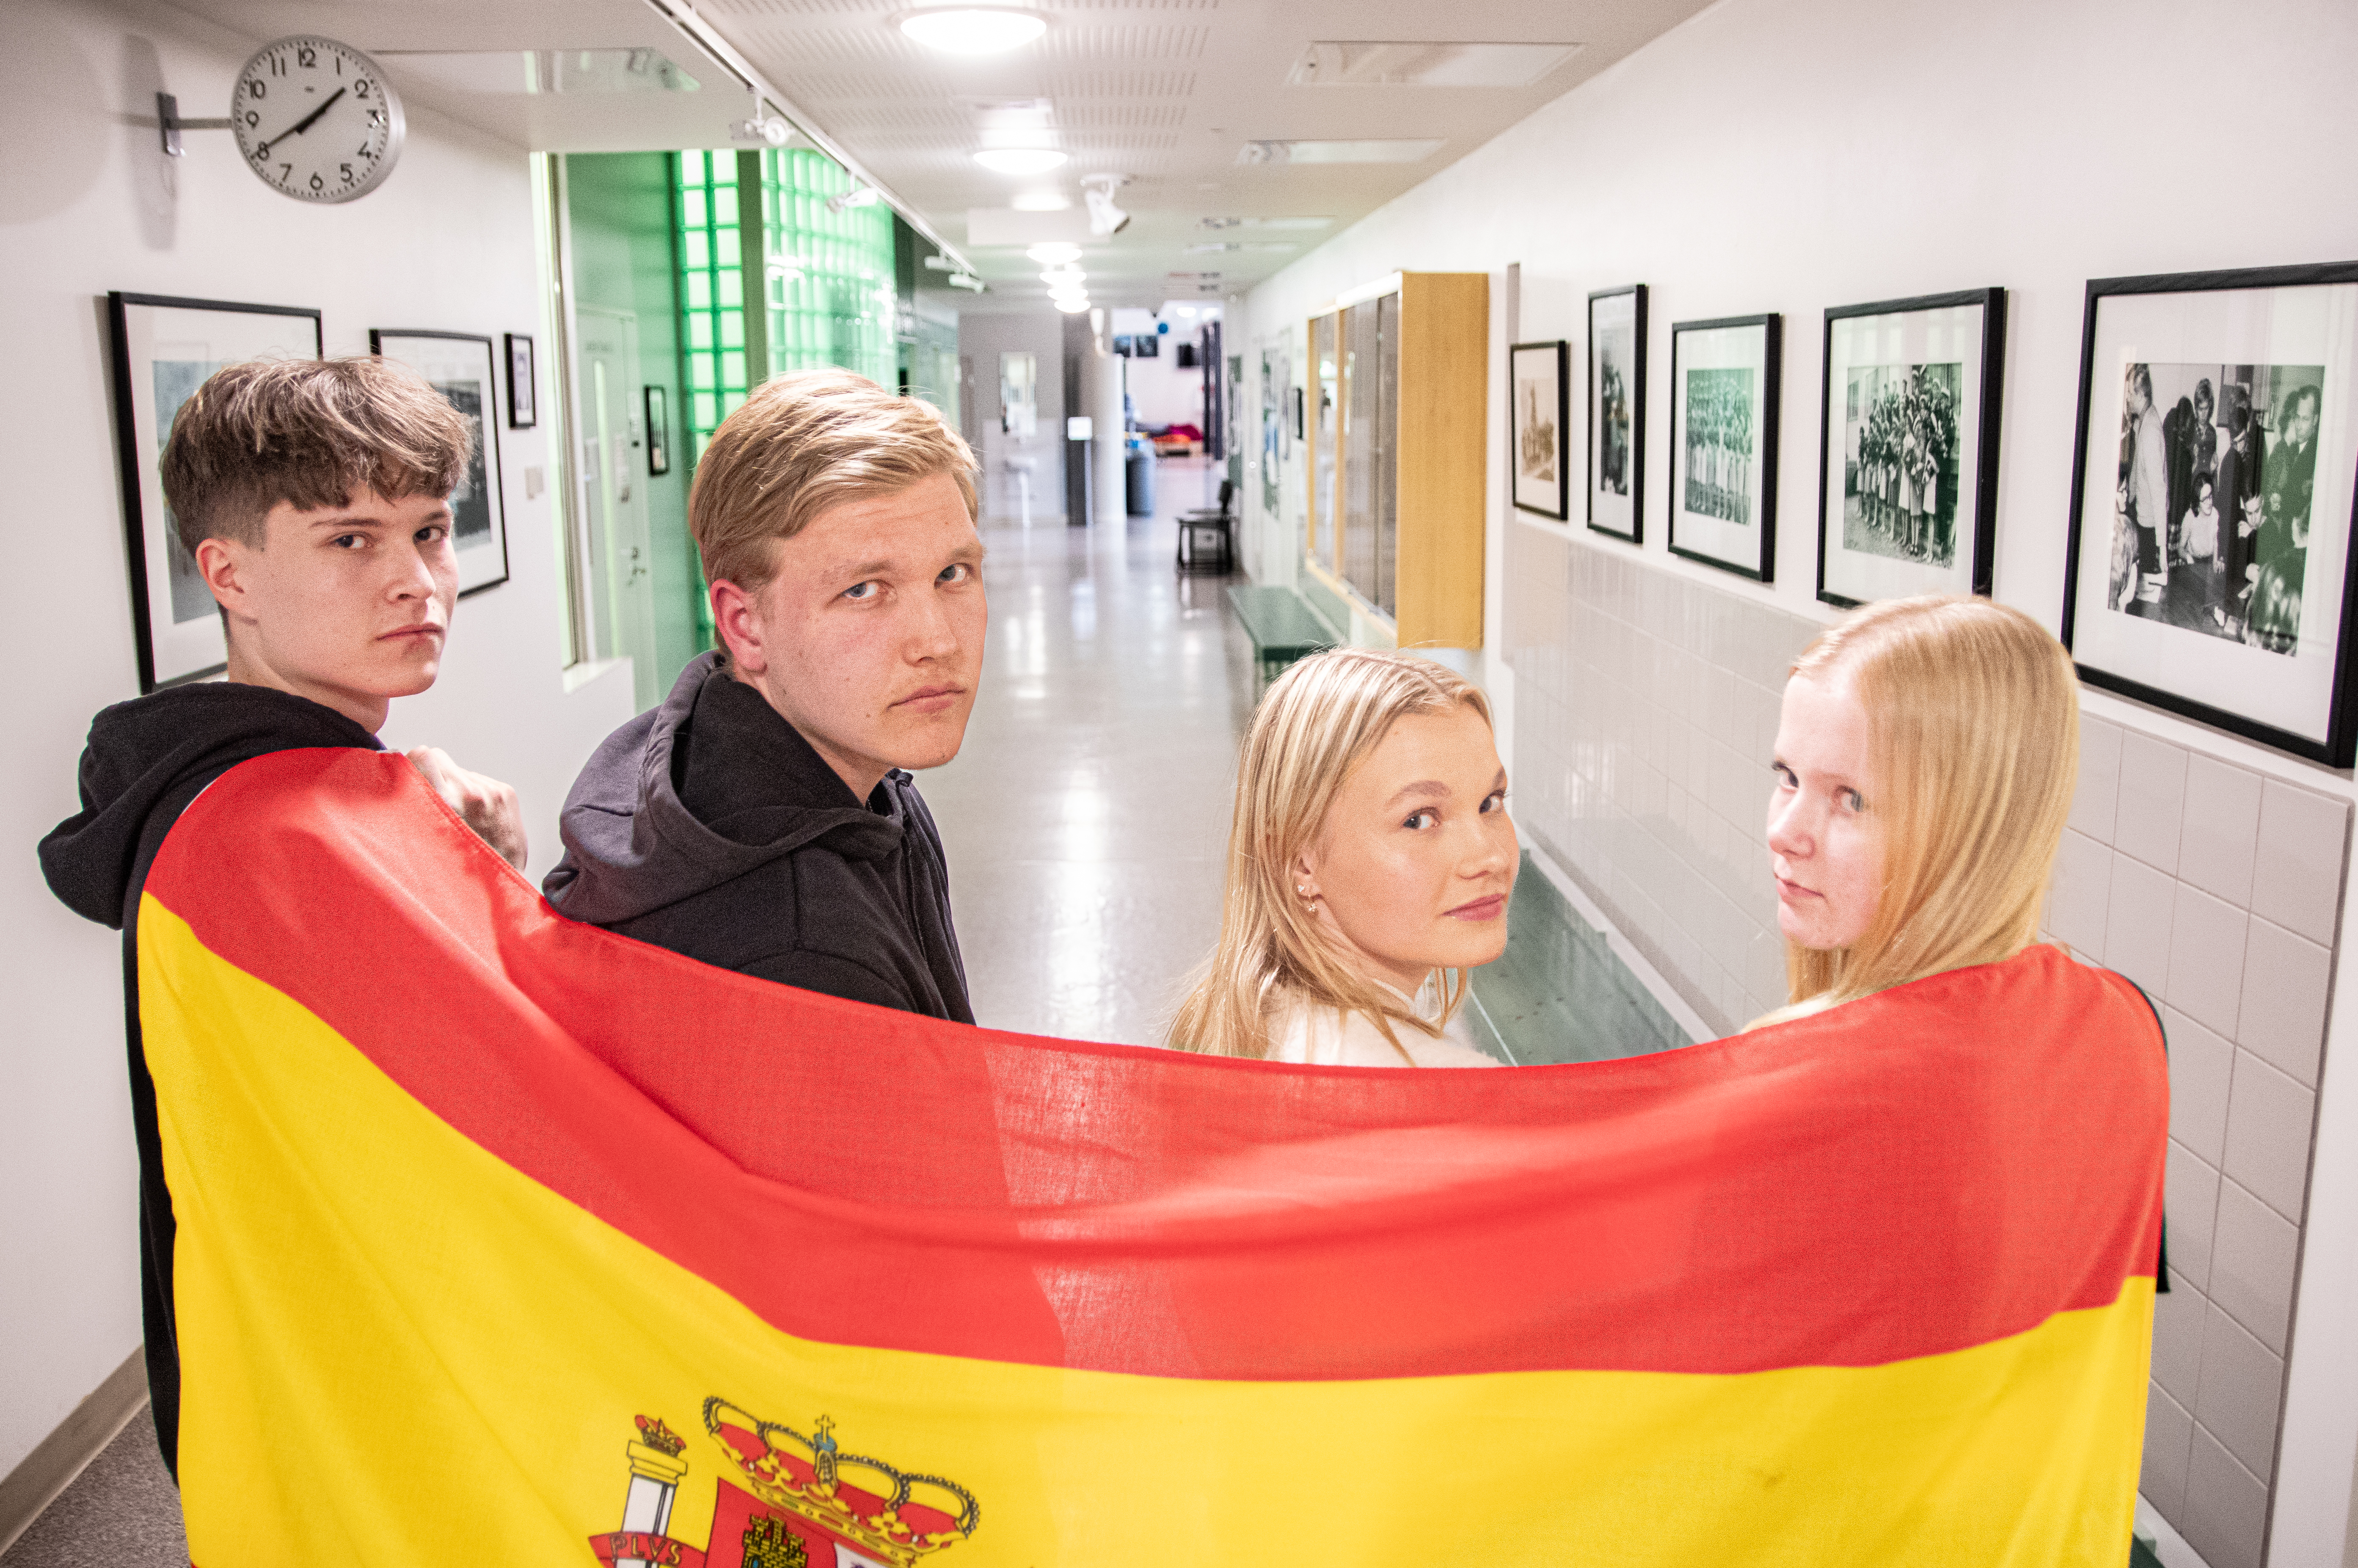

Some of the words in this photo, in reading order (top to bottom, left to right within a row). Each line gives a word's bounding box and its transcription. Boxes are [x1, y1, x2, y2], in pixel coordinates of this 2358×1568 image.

[270, 55, 286, 76] 11
[298, 47, 316, 67] 12
[336, 56, 341, 75] 1
[250, 79, 266, 99] 10
[355, 79, 369, 99] 2
[245, 111, 260, 129] 9
[257, 141, 269, 161] 8
[357, 141, 372, 159] 4
[279, 164, 292, 182] 7
[310, 171, 323, 191] 6
[340, 163, 353, 182] 5
[609, 1531, 683, 1567] PLVS
